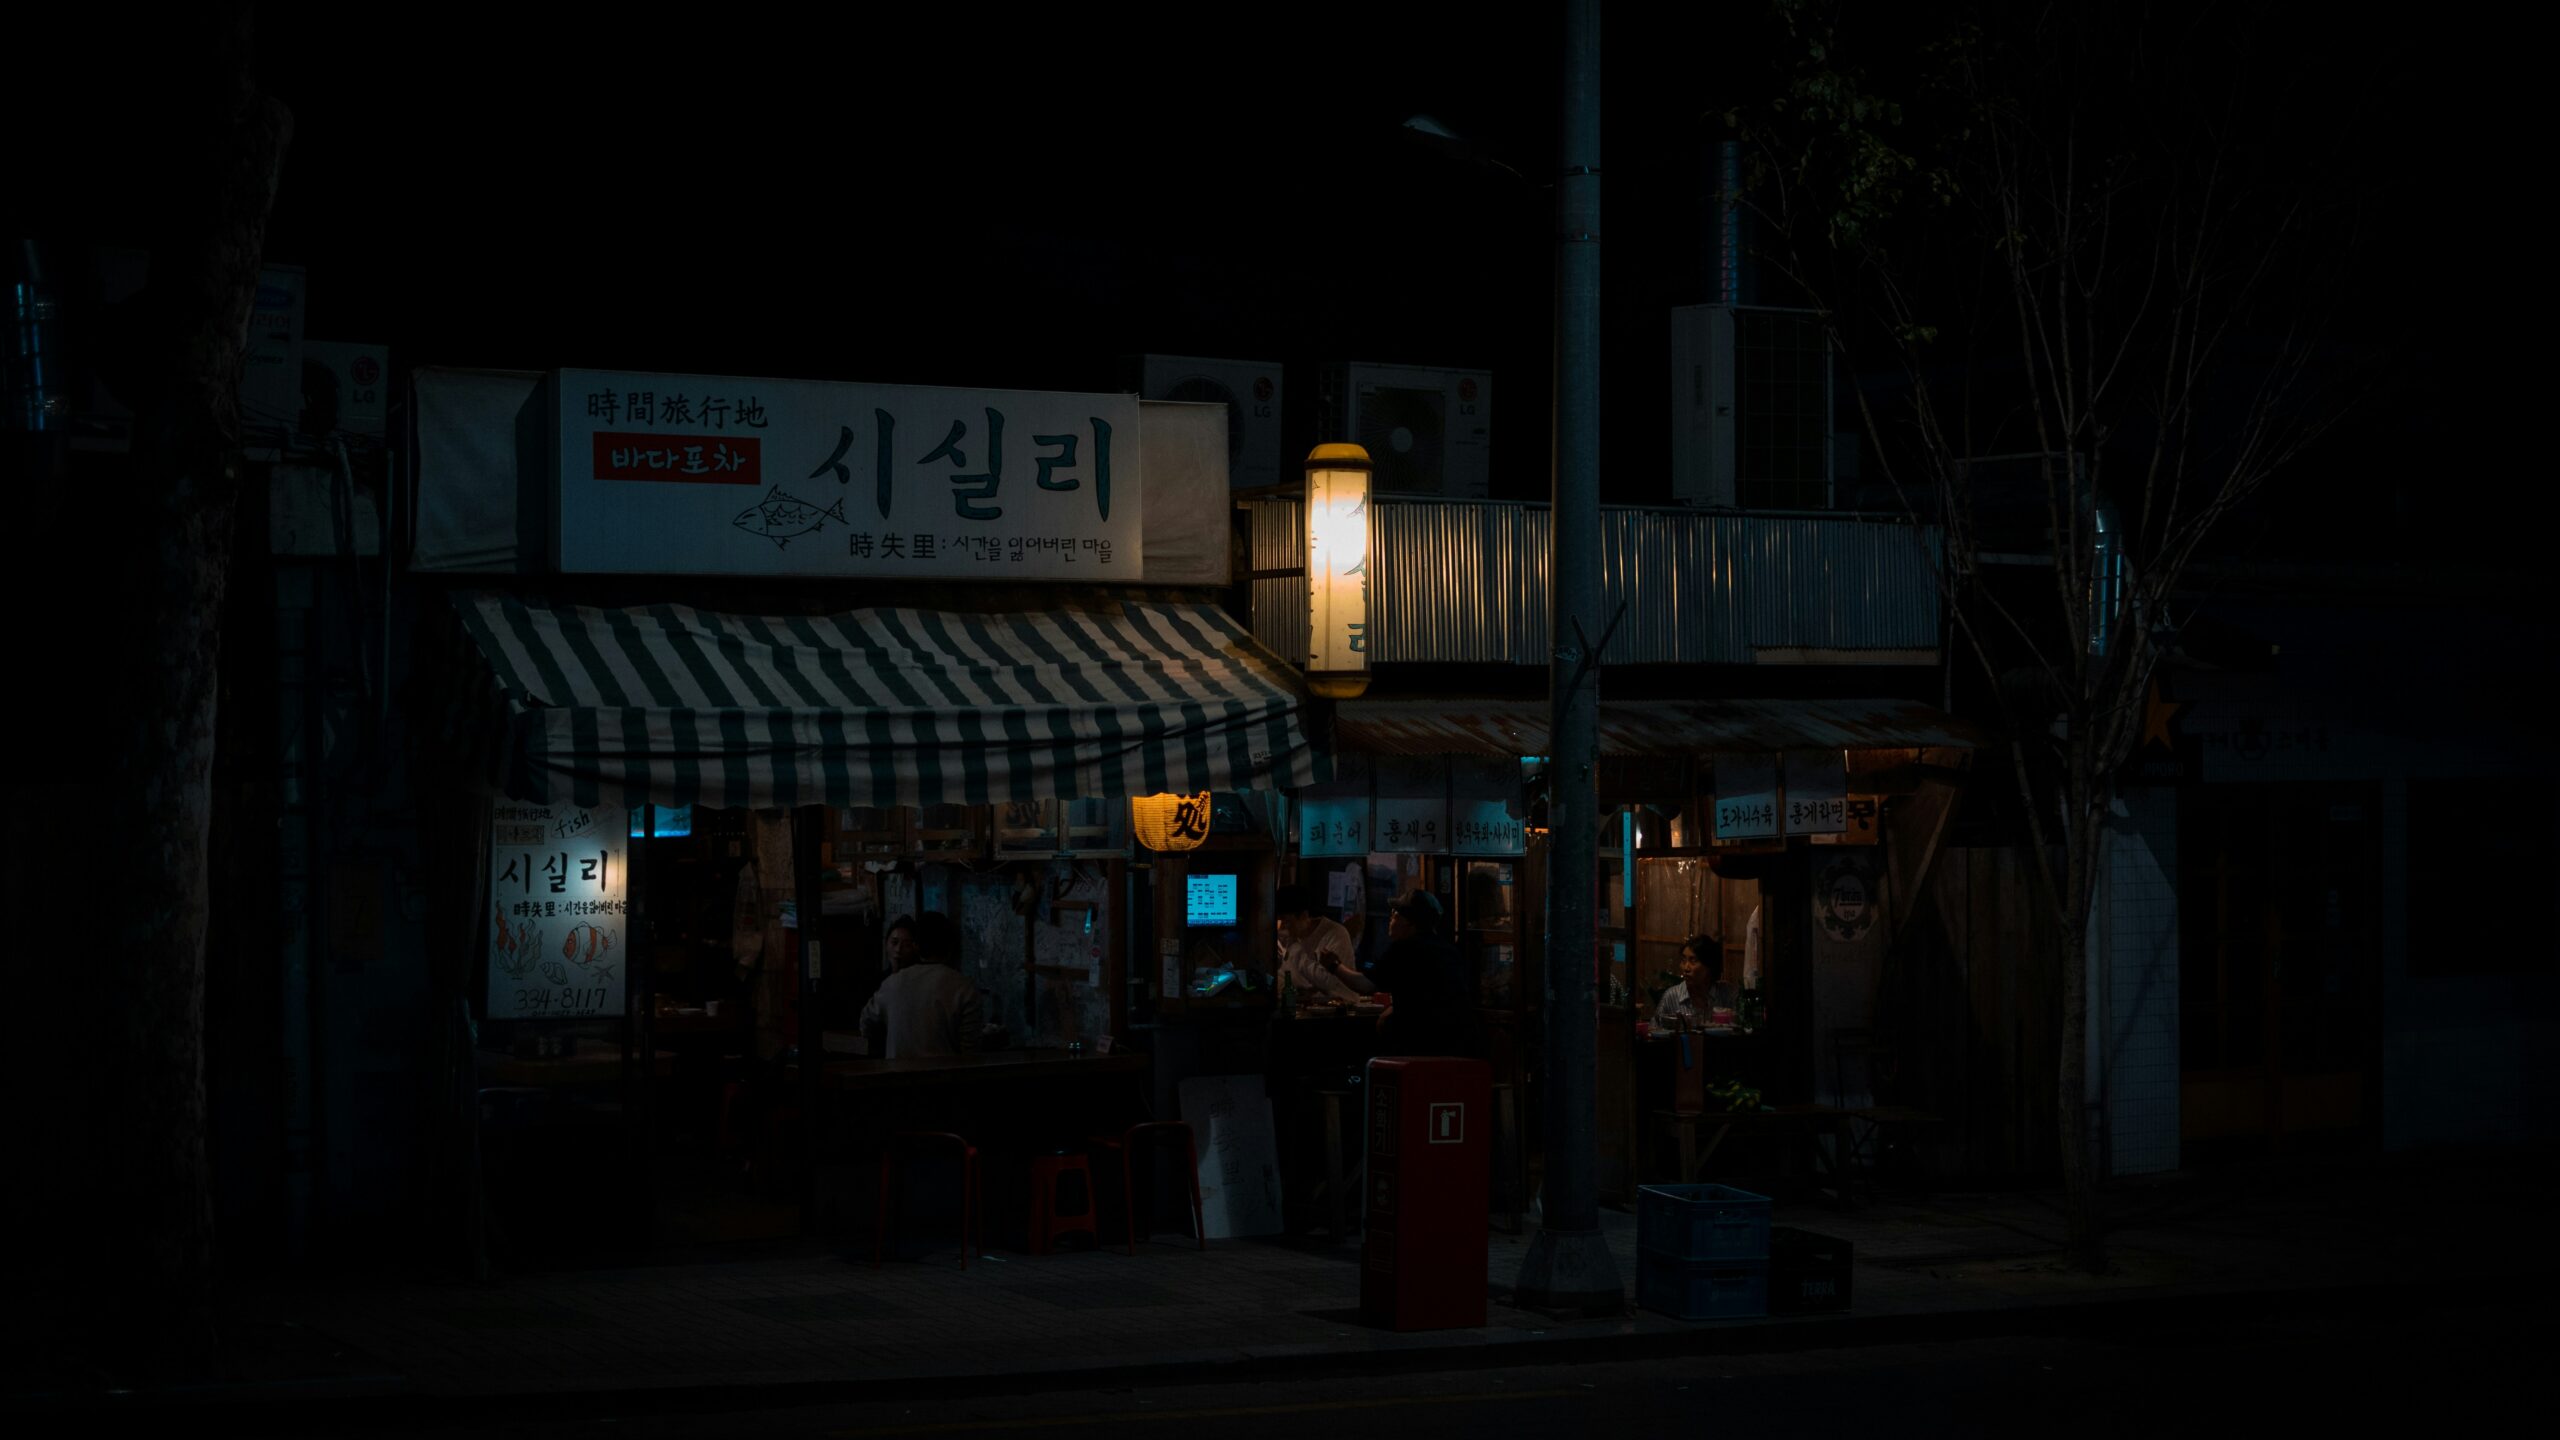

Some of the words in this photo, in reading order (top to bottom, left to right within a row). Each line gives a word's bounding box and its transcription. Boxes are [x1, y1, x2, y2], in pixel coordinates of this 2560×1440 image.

[353, 388, 375, 404] LG
[588, 388, 769, 430] 時間旅行地
[1254, 405, 1272, 419] LG
[1460, 405, 1476, 416] LG
[610, 443, 747, 475] 바다포차
[809, 407, 1113, 523] 시실리
[952, 535, 1002, 562] 시간을
[1008, 536, 1076, 563] 잃어버린
[1083, 537, 1113, 564] 마을
[555, 809, 591, 839] fish
[1719, 804, 1774, 829] 도가니수육
[1789, 801, 1844, 825] 홍게라면
[1384, 819, 1437, 844] 홍새우
[499, 850, 609, 894] 시실리
